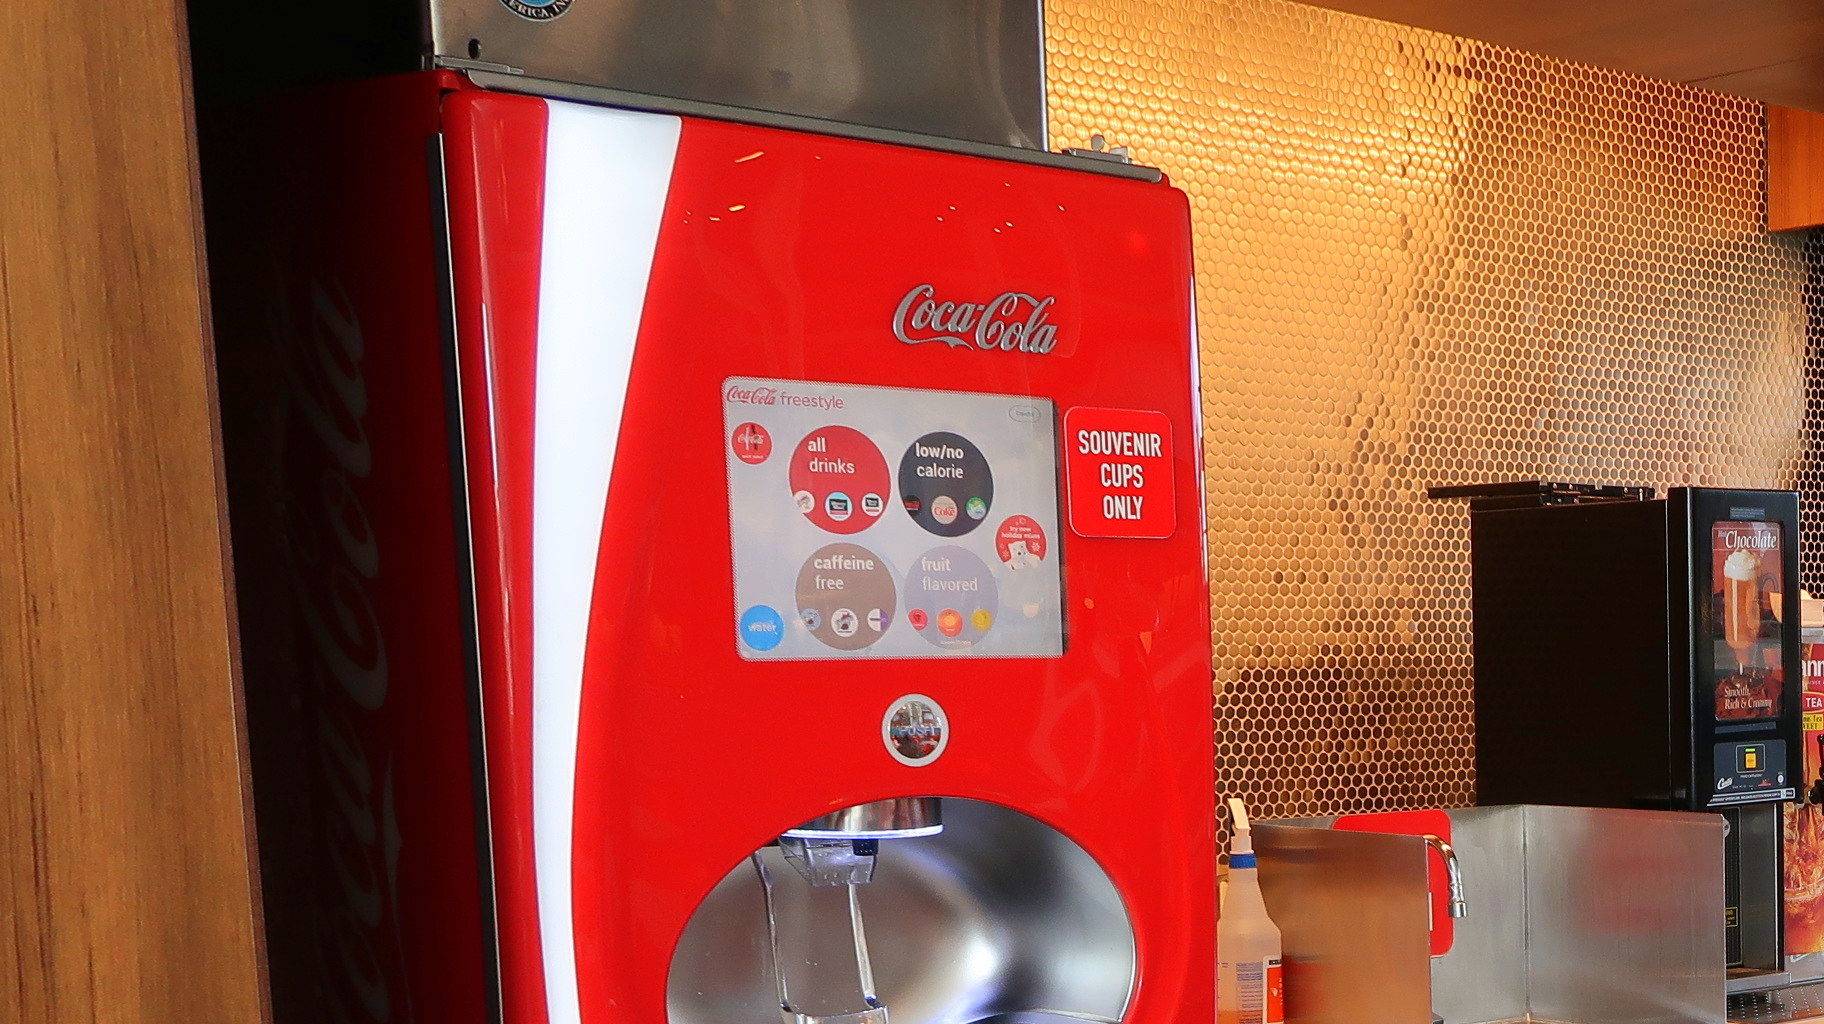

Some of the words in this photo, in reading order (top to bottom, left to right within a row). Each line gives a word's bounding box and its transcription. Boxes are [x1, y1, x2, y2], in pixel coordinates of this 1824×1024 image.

[892, 283, 1059, 354] Coca-Cola
[726, 385, 777, 406] Coca-Cola
[780, 392, 844, 410] freestyle
[807, 437, 826, 453] all
[915, 442, 964, 460] low/no
[1078, 429, 1162, 457] SOUVENIR
[809, 457, 856, 474] drinks
[916, 462, 964, 479] calorie
[1100, 463, 1144, 489] CUPS
[1103, 495, 1144, 520] ONLY
[1725, 530, 1777, 549] Chocolate
[813, 554, 875, 571] caffeine
[921, 556, 952, 572] fruit
[814, 575, 845, 590] free
[921, 576, 978, 592] flavored
[747, 622, 778, 634] water
[1805, 697, 1823, 708] TEA
[899, 725, 936, 736] PUSH
